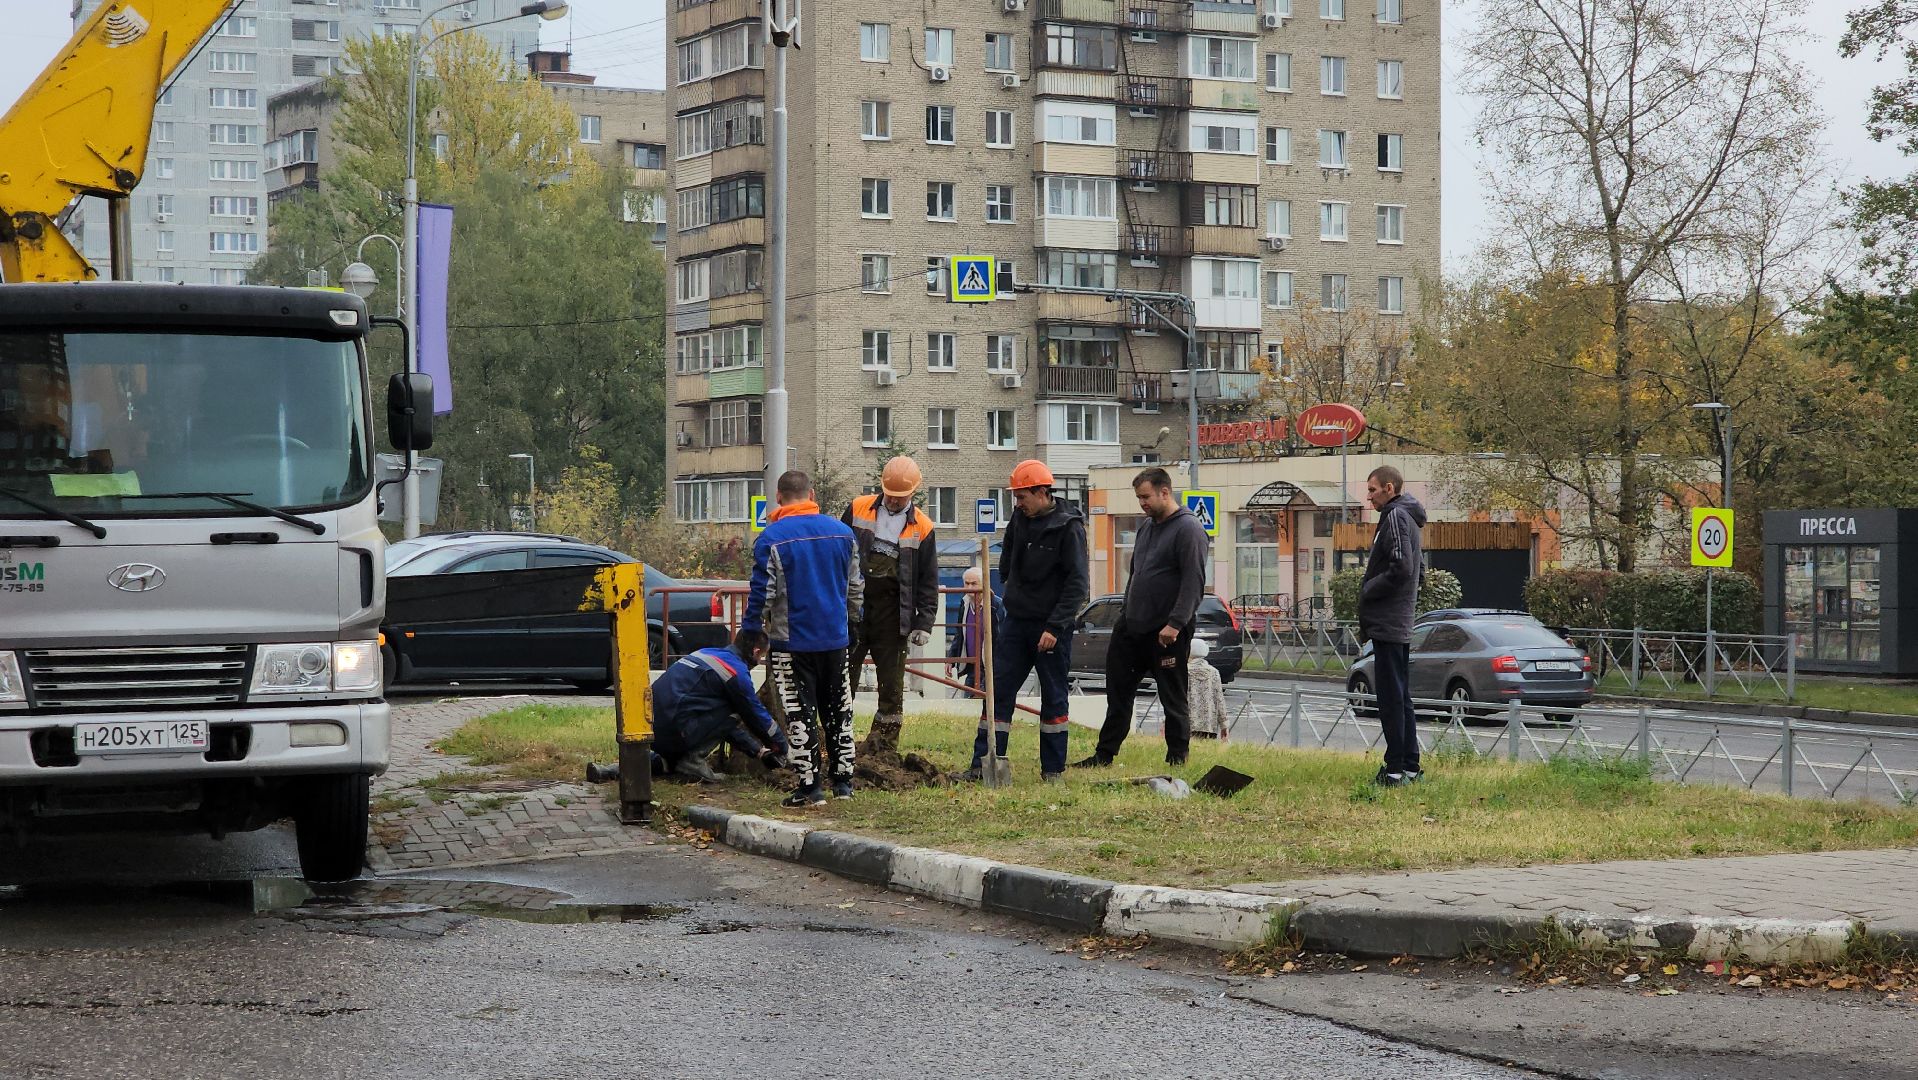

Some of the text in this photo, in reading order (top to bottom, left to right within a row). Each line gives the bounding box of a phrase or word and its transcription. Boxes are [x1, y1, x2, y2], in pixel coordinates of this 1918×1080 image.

[1187, 417, 1288, 445] НИВЕРСАМ
[1800, 517, 1857, 536] ПРЕССА
[1704, 528, 1721, 546] 20
[0, 562, 44, 581] sM
[83, 723, 200, 747] Н205ХТ 125
